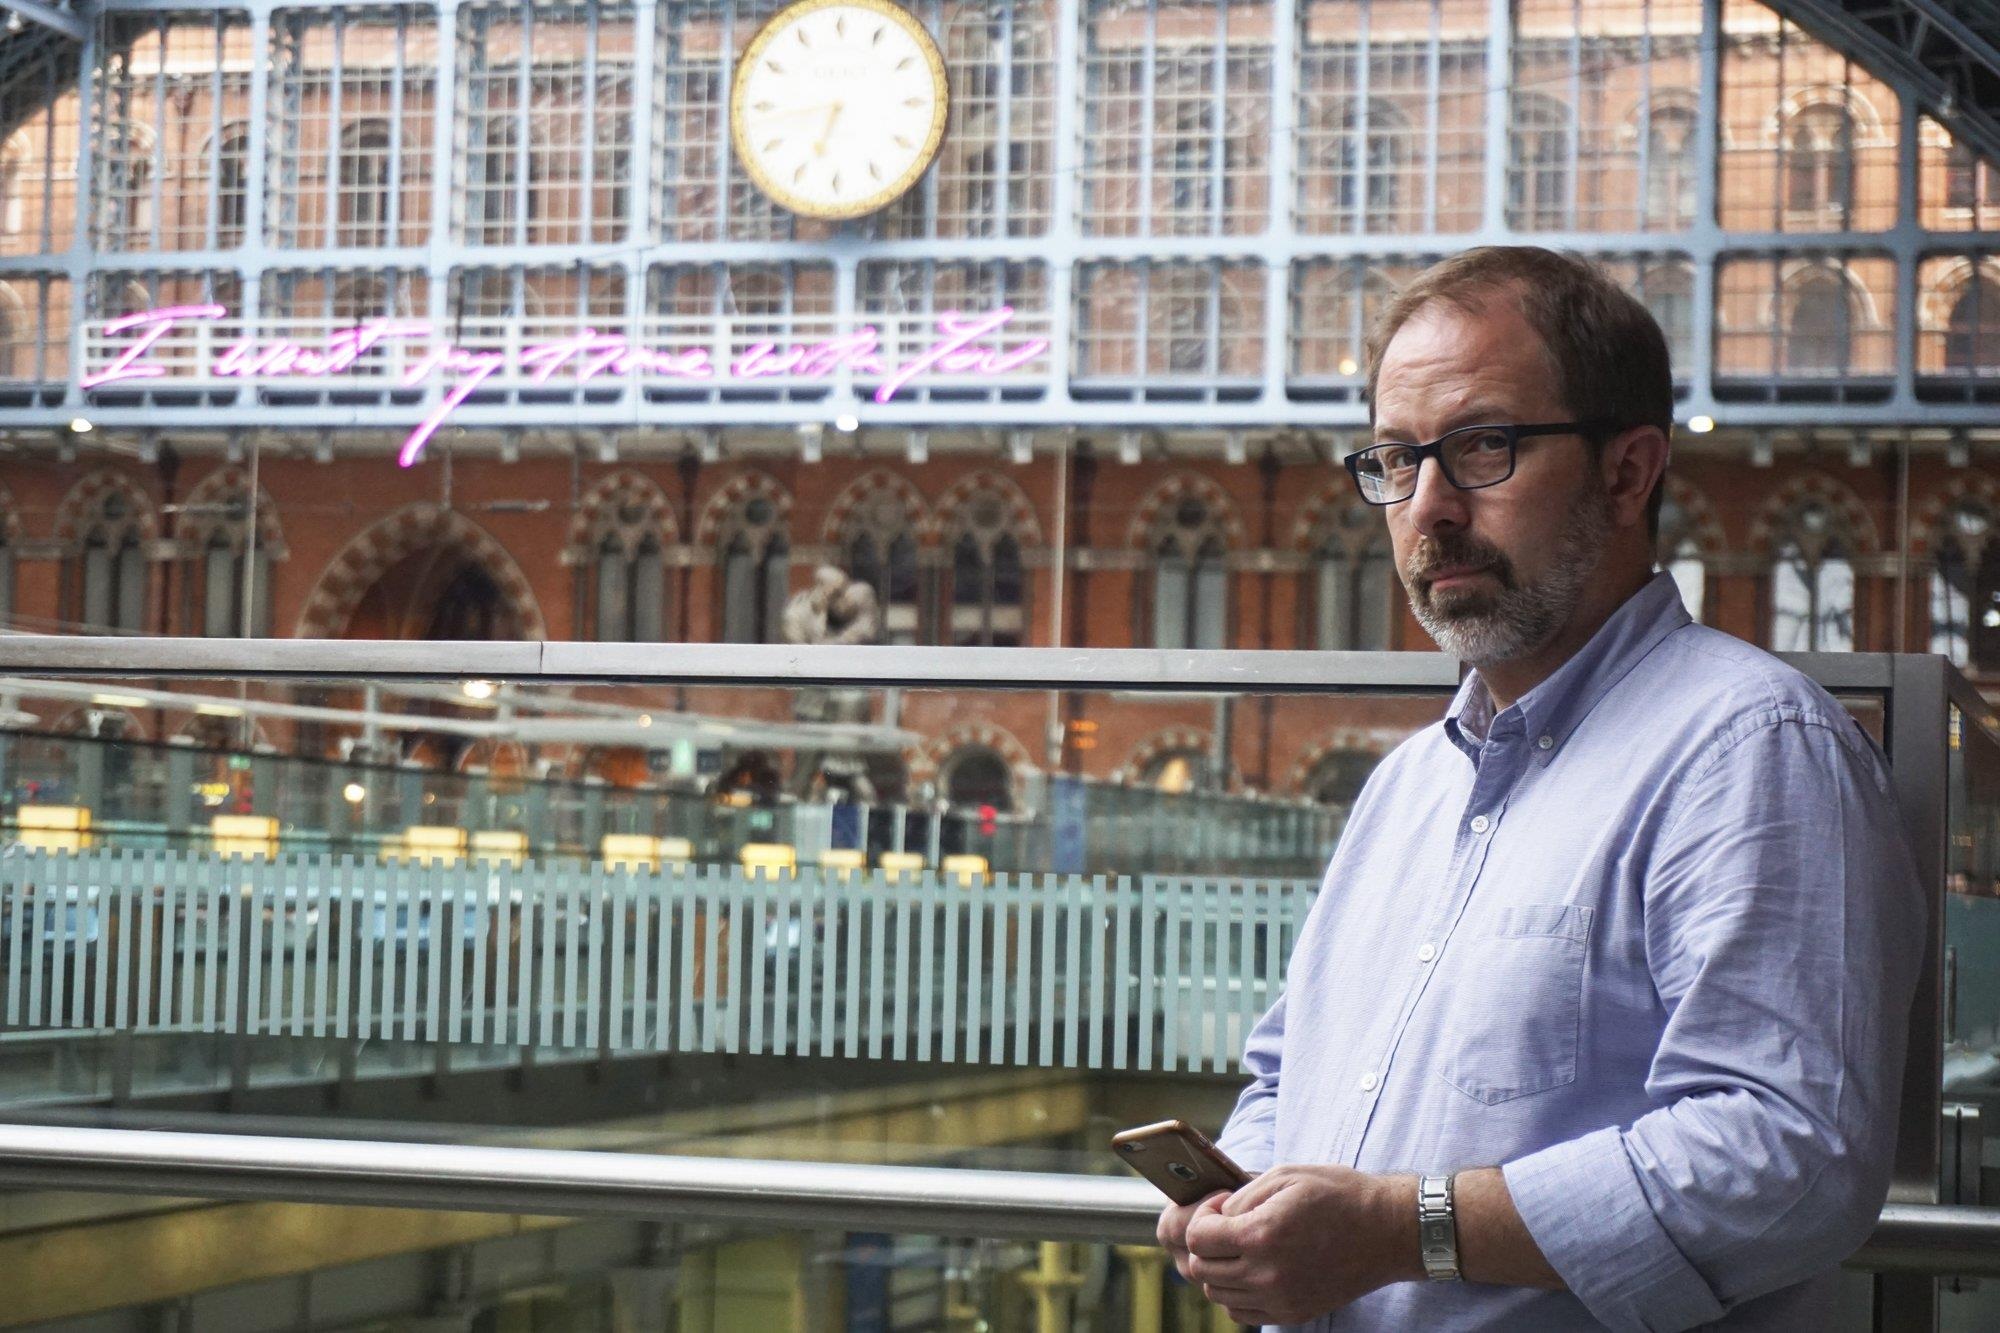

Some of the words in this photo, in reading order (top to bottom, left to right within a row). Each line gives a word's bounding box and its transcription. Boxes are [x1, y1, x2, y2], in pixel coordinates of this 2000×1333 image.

[79, 303, 226, 388] I
[212, 317, 434, 376] want
[398, 343, 506, 467] my
[730, 325, 886, 379] with
